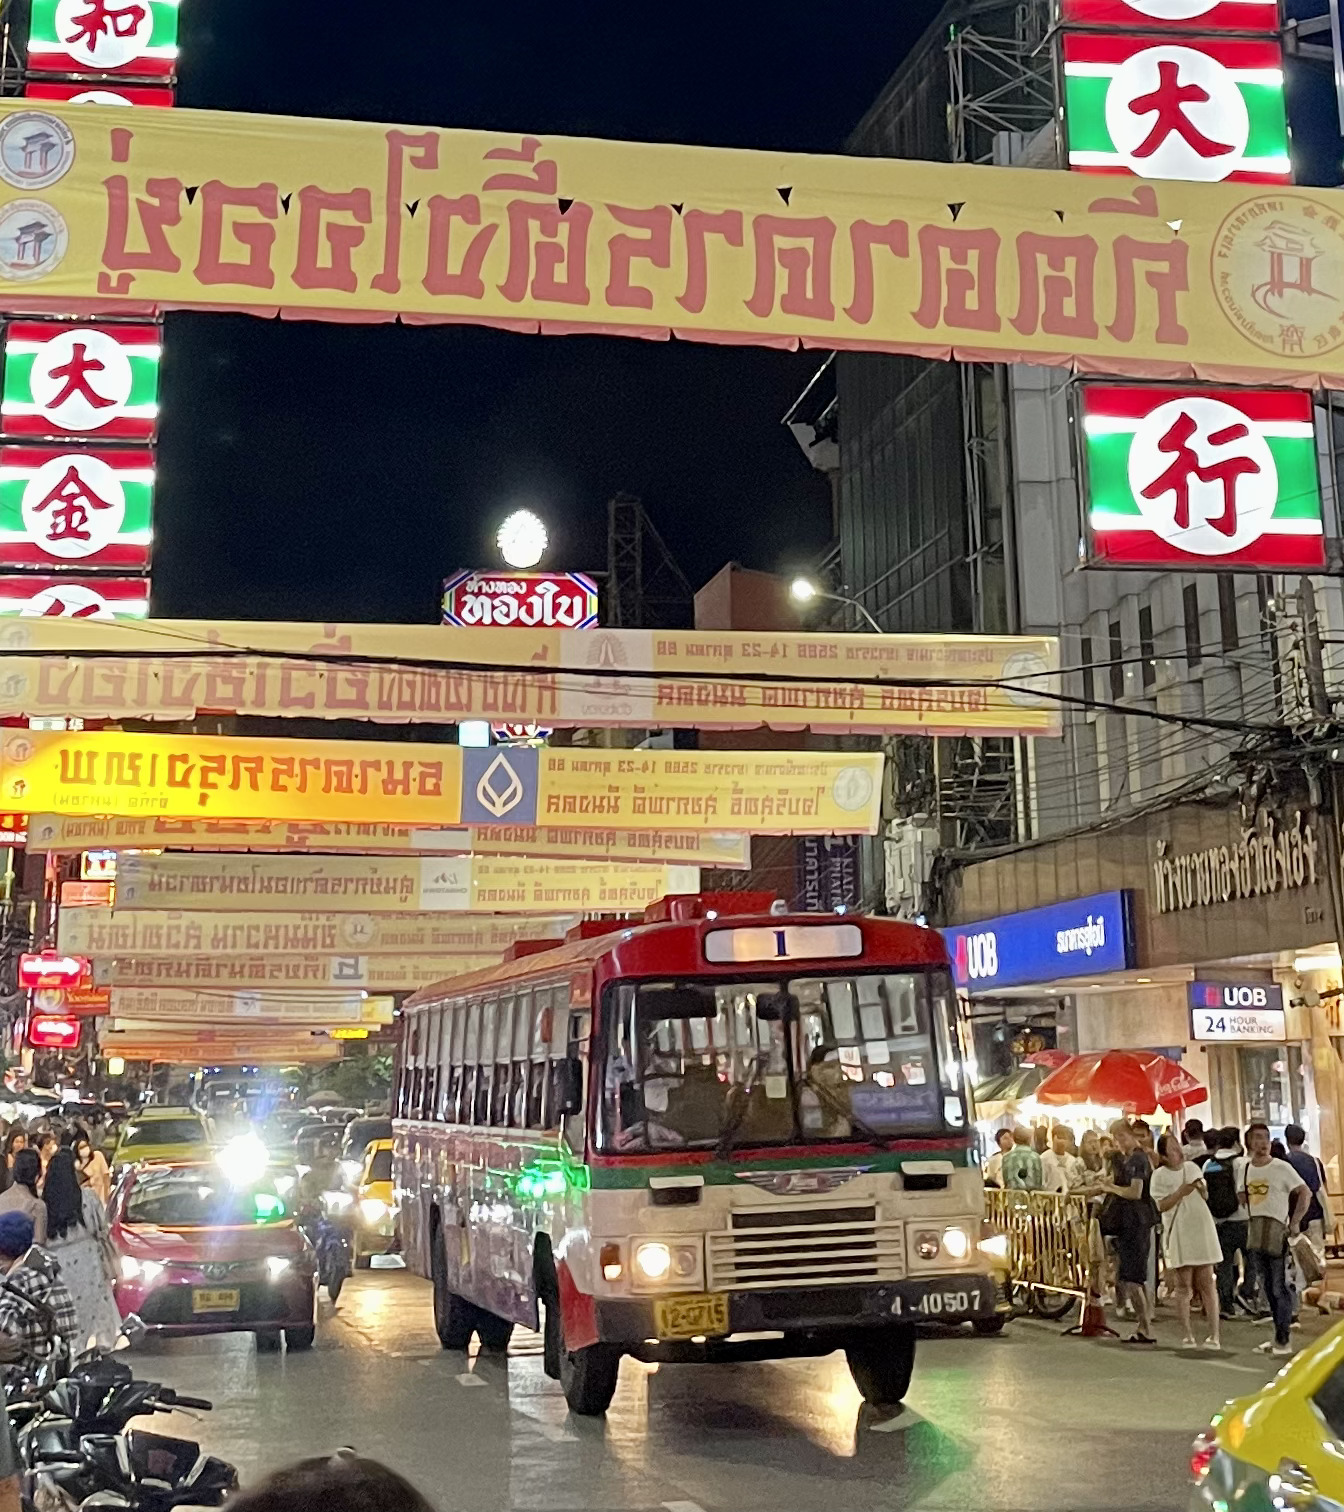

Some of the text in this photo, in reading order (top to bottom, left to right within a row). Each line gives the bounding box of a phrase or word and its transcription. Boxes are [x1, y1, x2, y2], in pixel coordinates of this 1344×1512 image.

[465, 575, 526, 595] ห้างทอง
[461, 581, 583, 626] ทองใบ
[773, 929, 787, 957] 1
[967, 932, 998, 979] UOB
[1224, 986, 1267, 1007] UOB
[1205, 1016, 1257, 1033] 24 HOUR
[1230, 1024, 1273, 1035] BANKING
